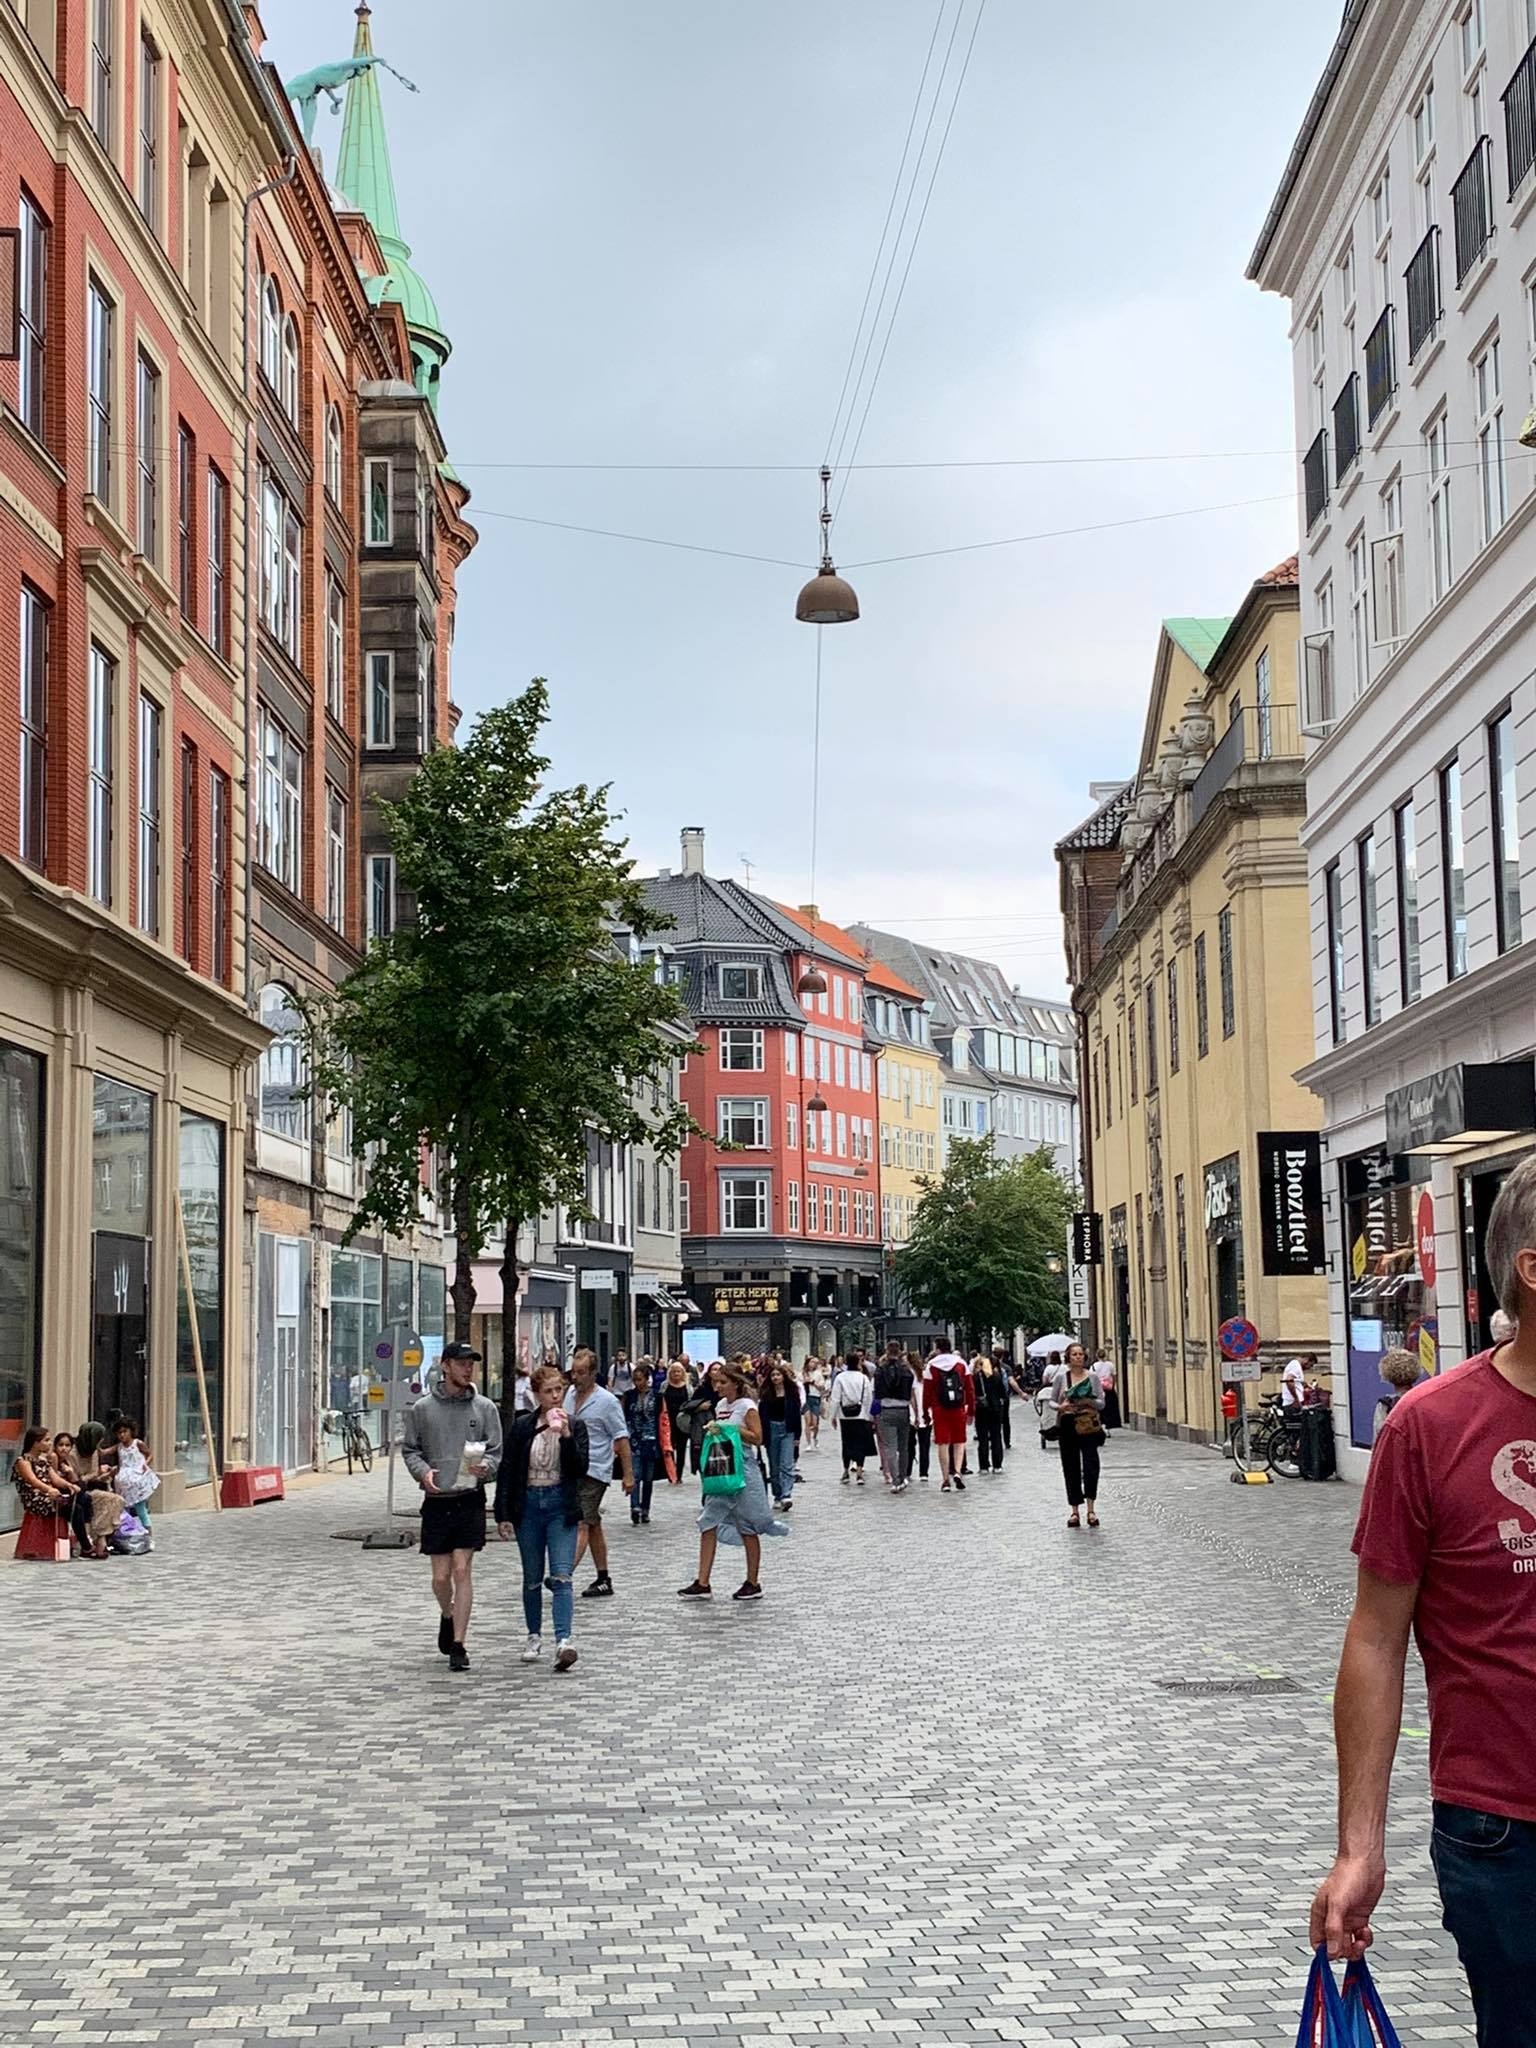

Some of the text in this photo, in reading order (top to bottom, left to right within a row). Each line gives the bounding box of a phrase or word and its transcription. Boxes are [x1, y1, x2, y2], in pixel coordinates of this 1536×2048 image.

[1275, 1183, 1283, 1219] DESIGNER
[1286, 1150, 1309, 1254] Booztlet
[1082, 1216, 1092, 1260] SEPHORA
[1276, 1224, 1284, 1252] OUTLET
[714, 1287, 746, 1298] PETER
